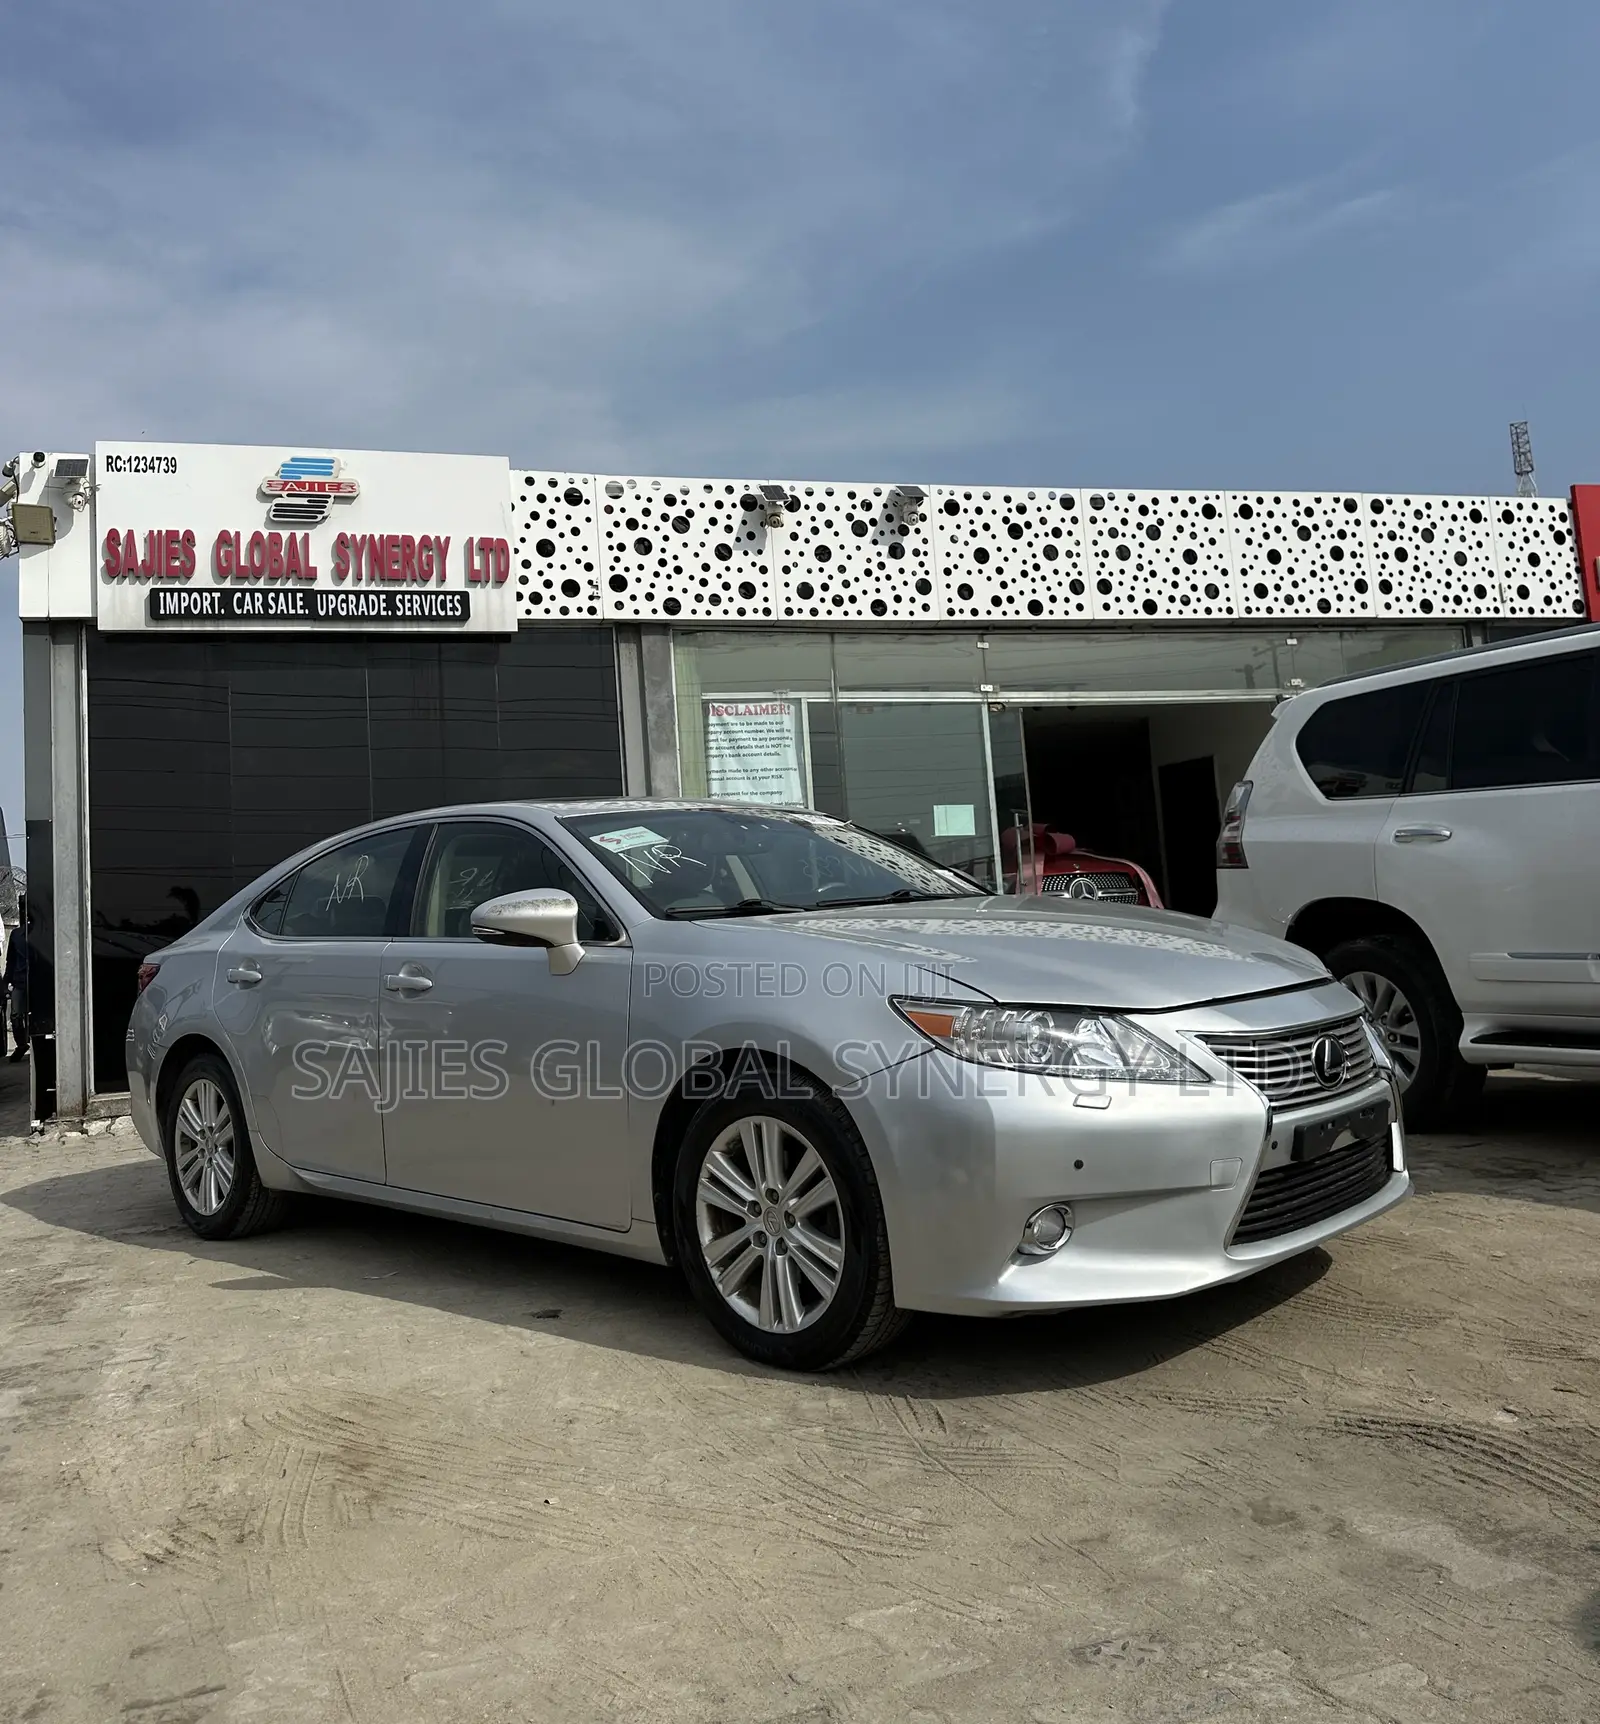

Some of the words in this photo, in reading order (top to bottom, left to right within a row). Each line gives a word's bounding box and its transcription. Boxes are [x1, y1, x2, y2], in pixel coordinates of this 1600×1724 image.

[106, 455, 178, 473] RC:1234739
[266, 480, 357, 493] SAJIES
[105, 528, 197, 579] SAJIES
[215, 529, 318, 581] GLOBAL
[336, 532, 451, 582] SYNERGY
[468, 536, 511, 584] LTD
[158, 591, 225, 615] IMPORT.
[232, 592, 264, 615] CAR
[268, 592, 309, 615] SALE.
[316, 593, 392, 616] UPGRADE.
[395, 593, 462, 616] SERVICES
